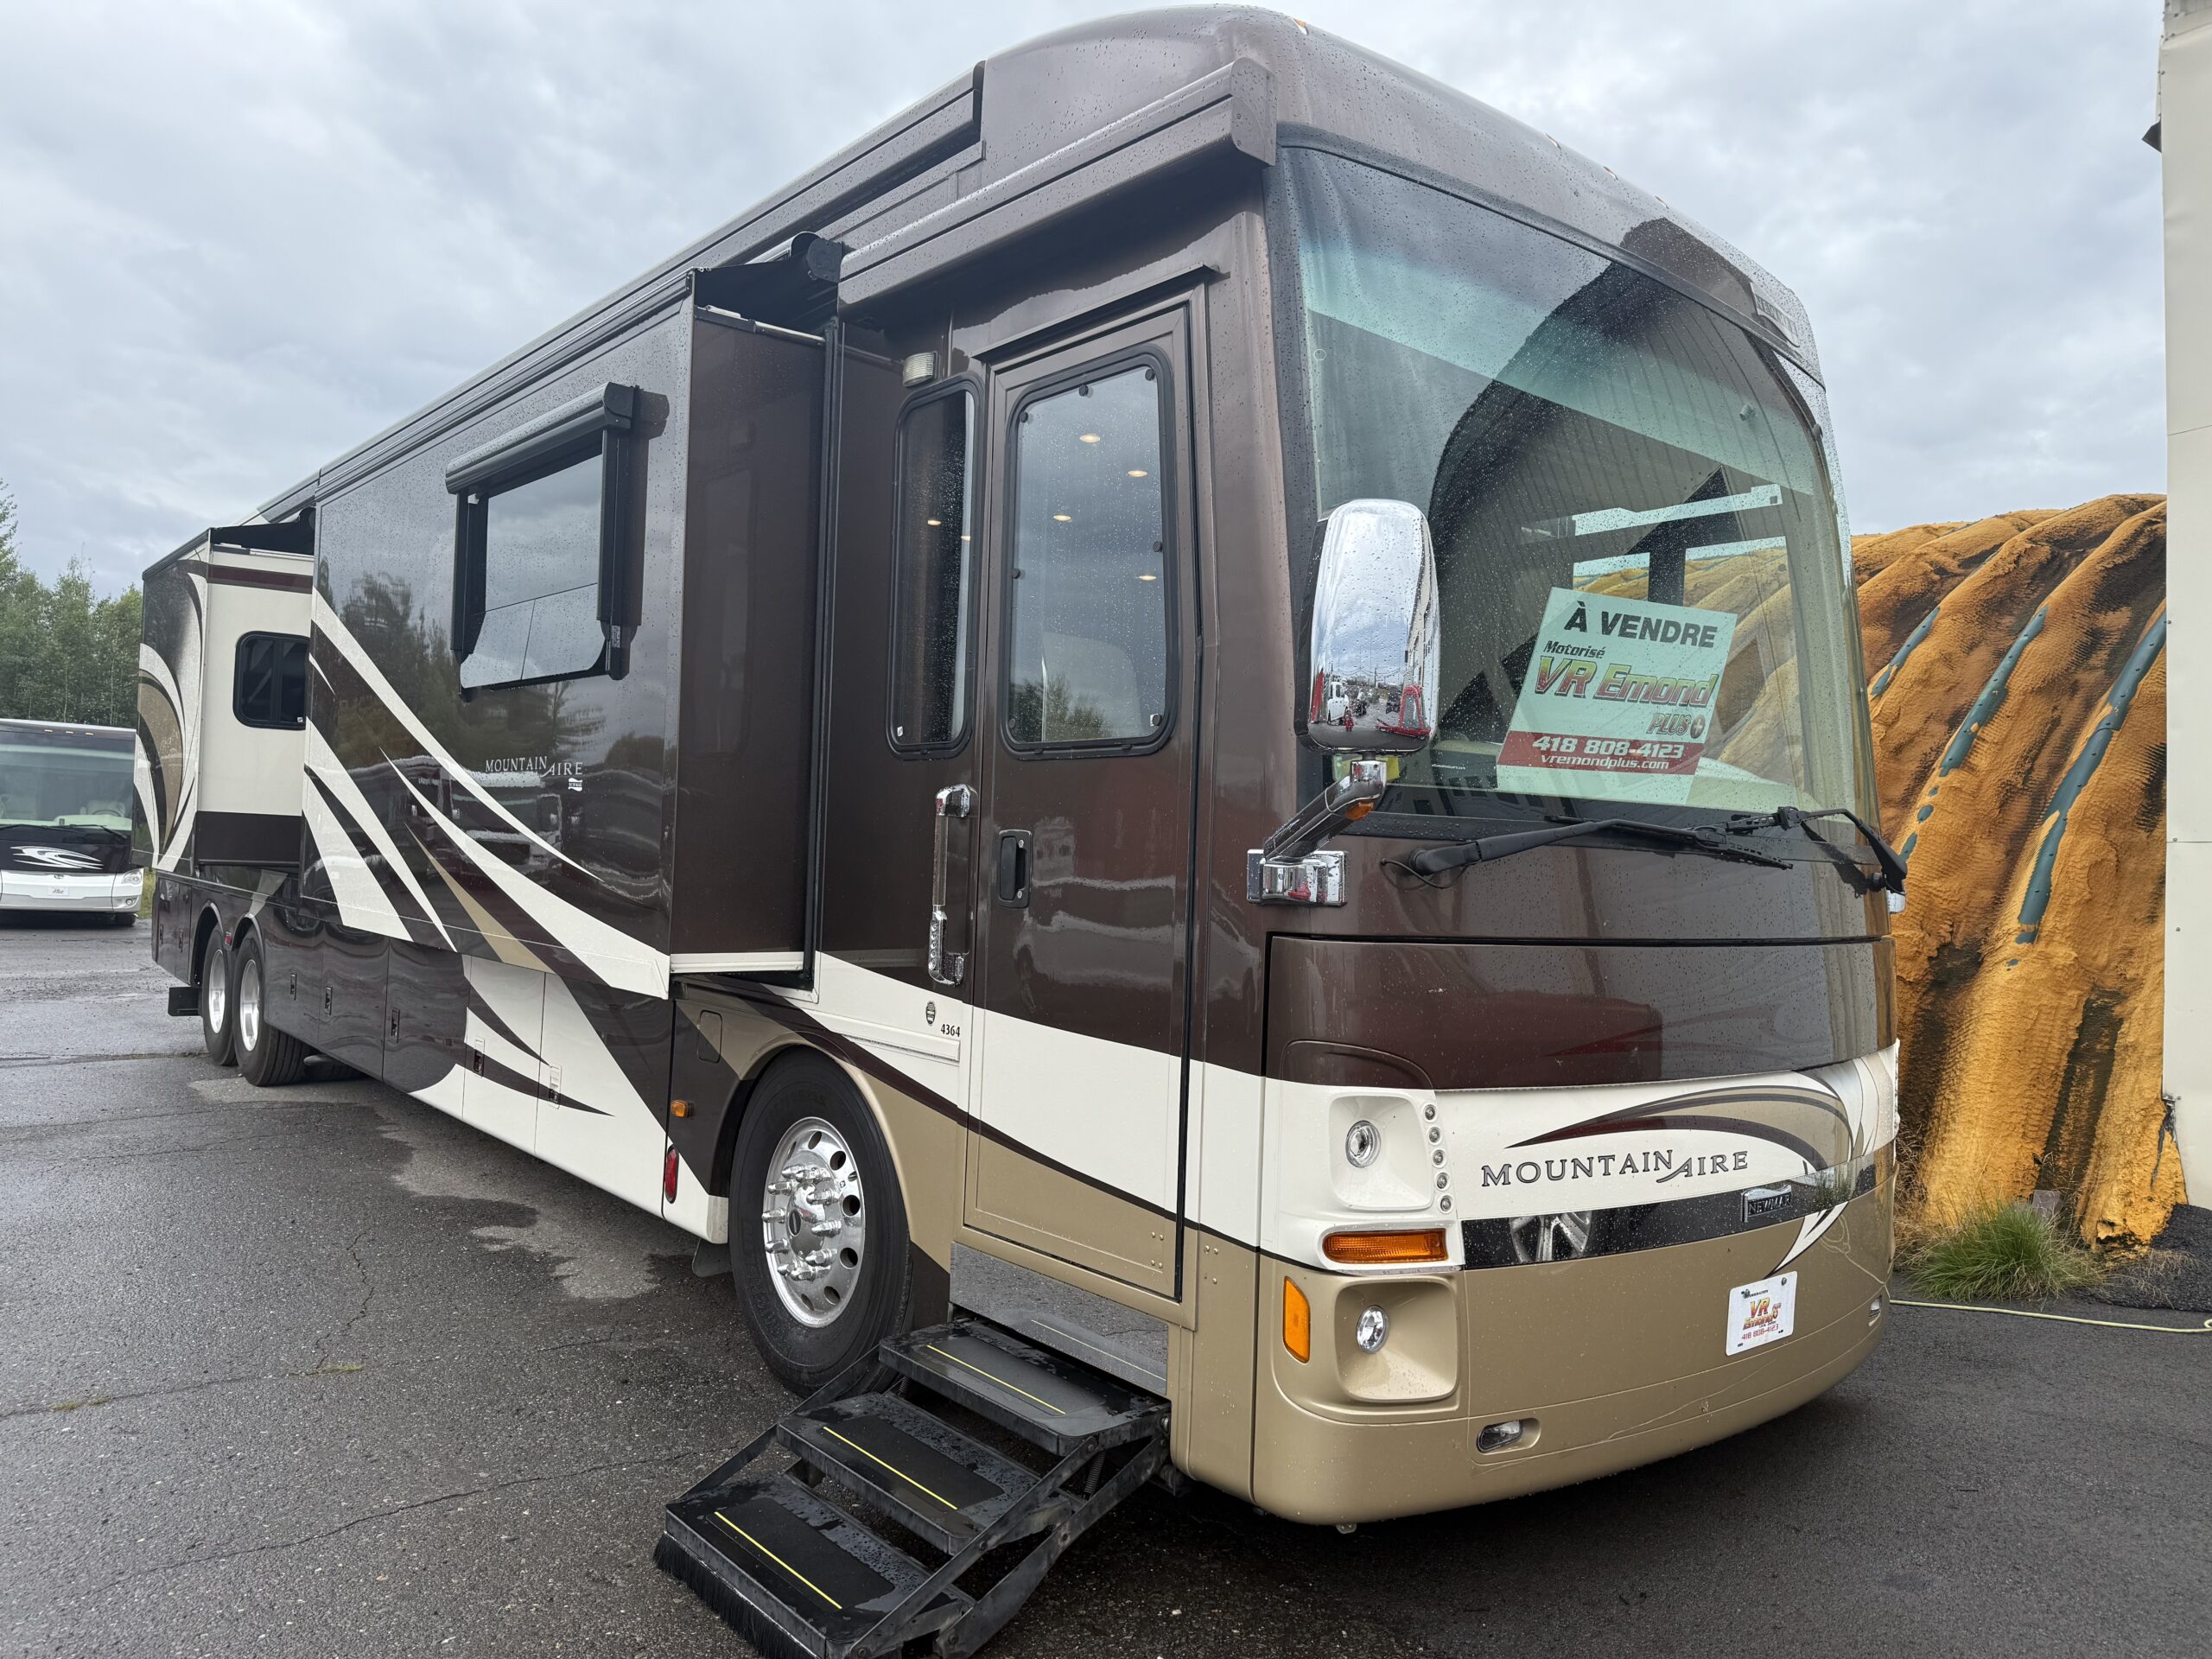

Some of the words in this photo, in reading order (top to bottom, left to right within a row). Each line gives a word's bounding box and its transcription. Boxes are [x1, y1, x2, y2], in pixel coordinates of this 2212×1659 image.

[1564, 601, 1588, 633] À
[1600, 611, 1718, 648] VENDRE
[1543, 640, 1606, 659] Motorisé
[1535, 656, 1598, 698] VR
[1593, 663, 1719, 707] Emond
[1532, 736, 1578, 753] 418
[1584, 740, 1684, 759] 808-4123
[1541, 754, 1669, 769] vremondplus.com
[941, 1024, 960, 1037] 4364
[1750, 1297, 1770, 1318] VR
